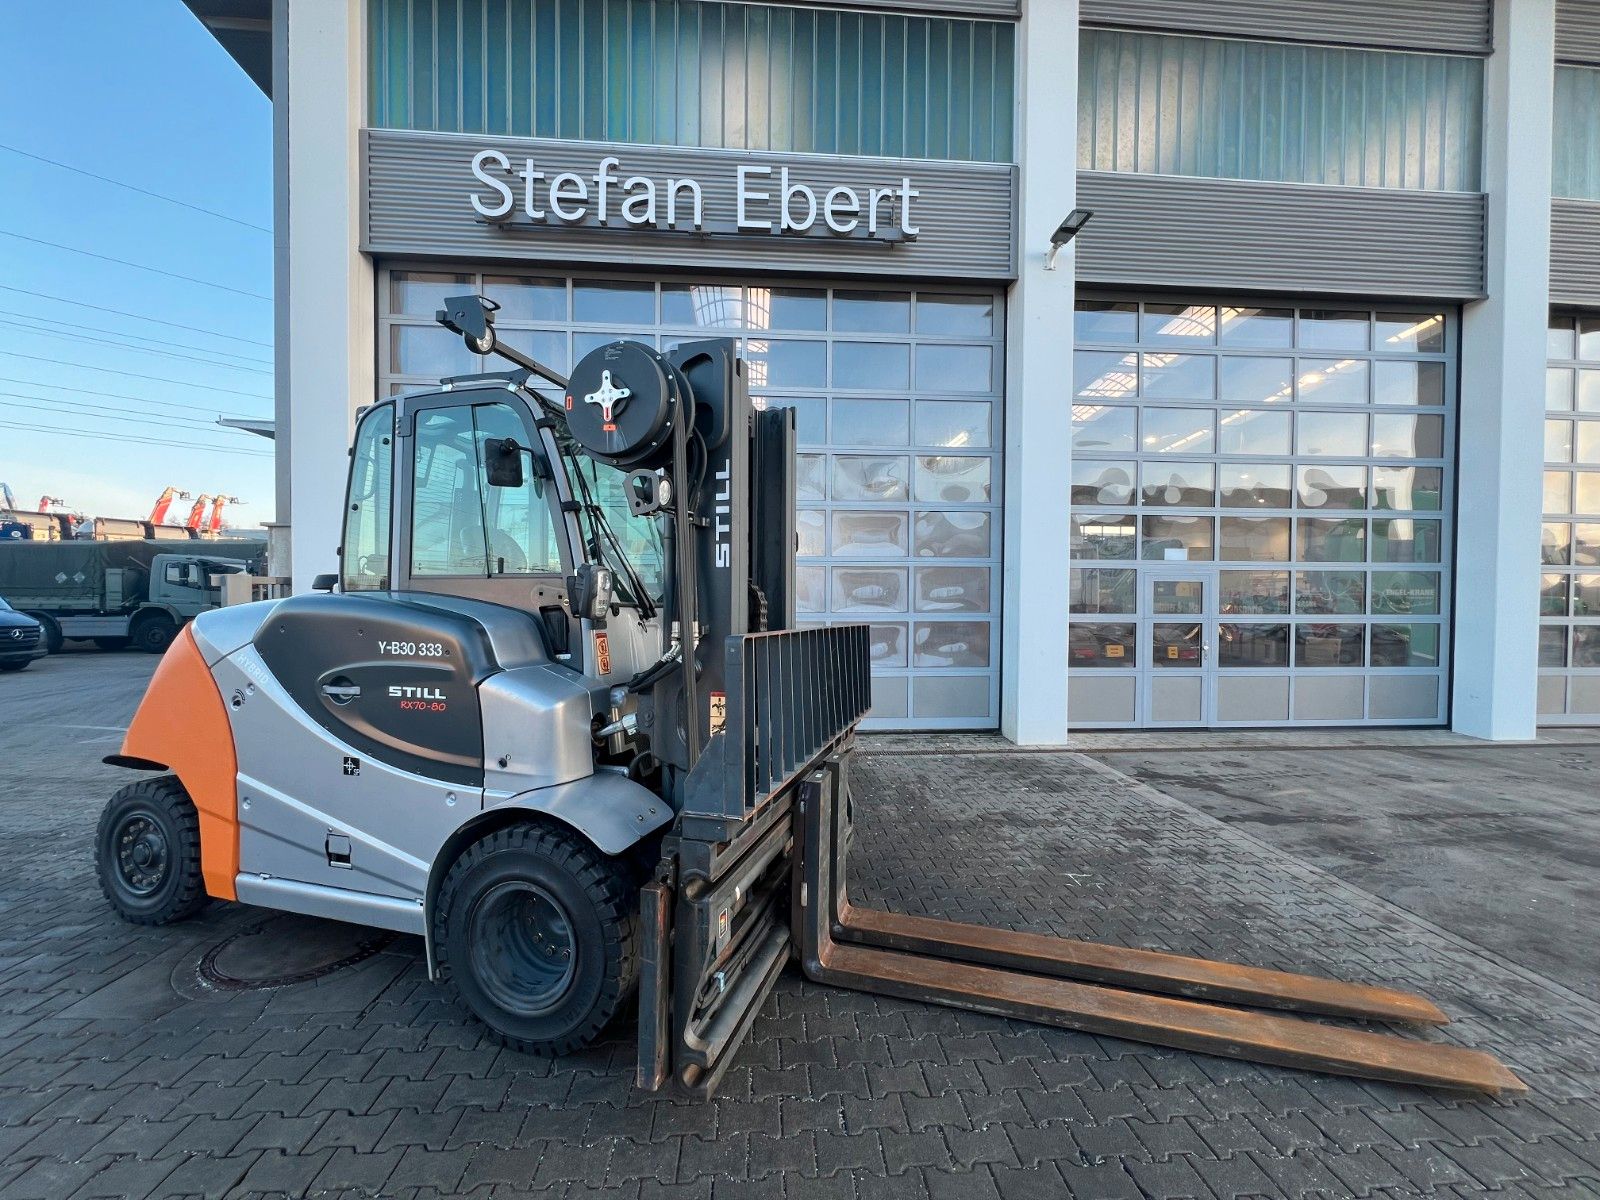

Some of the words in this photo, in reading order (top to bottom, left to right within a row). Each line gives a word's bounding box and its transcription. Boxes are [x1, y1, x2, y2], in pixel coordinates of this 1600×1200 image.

[470, 149, 702, 227] Stefan
[736, 165, 920, 240] Ebert
[715, 458, 730, 568] STILL
[378, 641, 416, 656] Y-B30
[418, 643, 443, 657] 333
[388, 686, 447, 699] STILL
